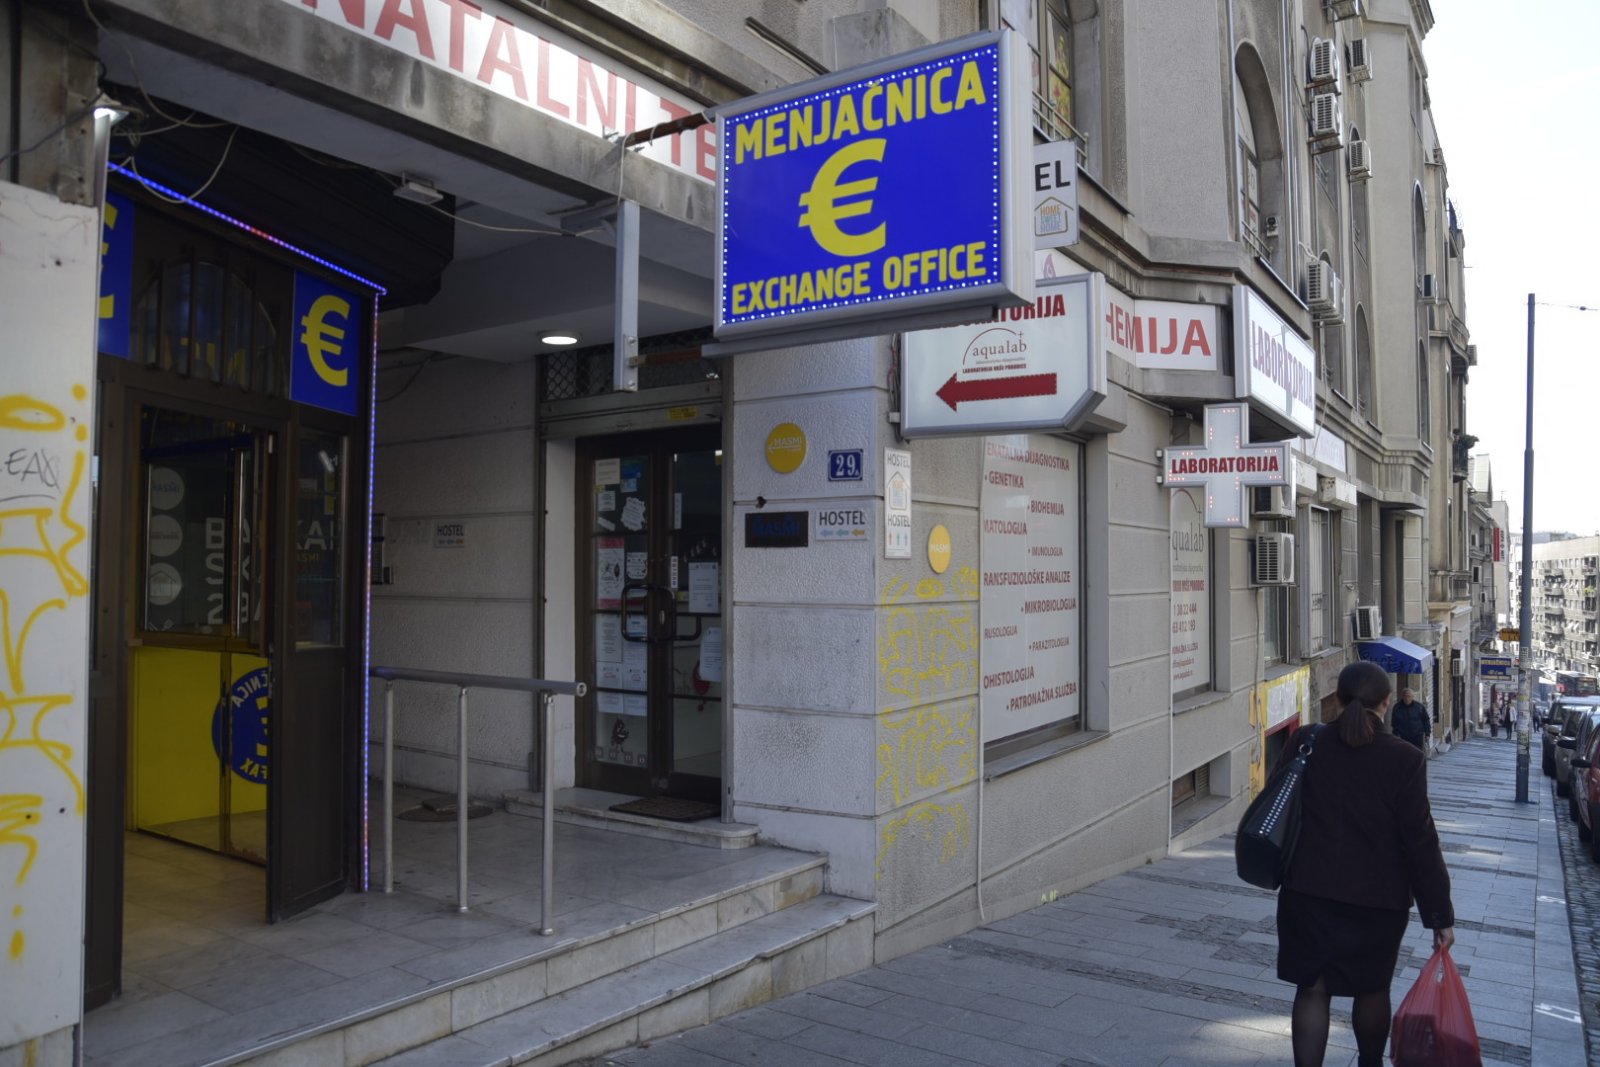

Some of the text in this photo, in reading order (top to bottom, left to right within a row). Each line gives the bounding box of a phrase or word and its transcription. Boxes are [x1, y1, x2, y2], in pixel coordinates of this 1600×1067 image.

[734, 60, 987, 165] MENJAČNICA
[1040, 204, 1061, 216] HOME
[731, 241, 987, 316] EXCHANGE OFFICE
[972, 339, 1027, 359] aqualab
[1252, 320, 1313, 411] LABORATORIJA
[887, 453, 911, 469] HOSTEL
[1025, 450, 1070, 471] DIJAGNOSTIKA
[1172, 456, 1279, 474] LABORATORIJA
[989, 470, 1024, 488] GENETIKA
[1030, 500, 1065, 516] BIOHEMIJA
[819, 510, 866, 526] HOSTEL
[888, 514, 911, 528] HOSTEL
[437, 525, 464, 537] HOSTEL
[1031, 546, 1063, 557] IMUNOLOGIJA
[1046, 570, 1071, 584] ANALIZE
[1024, 597, 1077, 614] MIKROBIOLOGIJA
[1032, 636, 1070, 652] PARAZITOLOGIJA
[1010, 681, 1078, 712] PATRONAŽNA SLUŽBA
